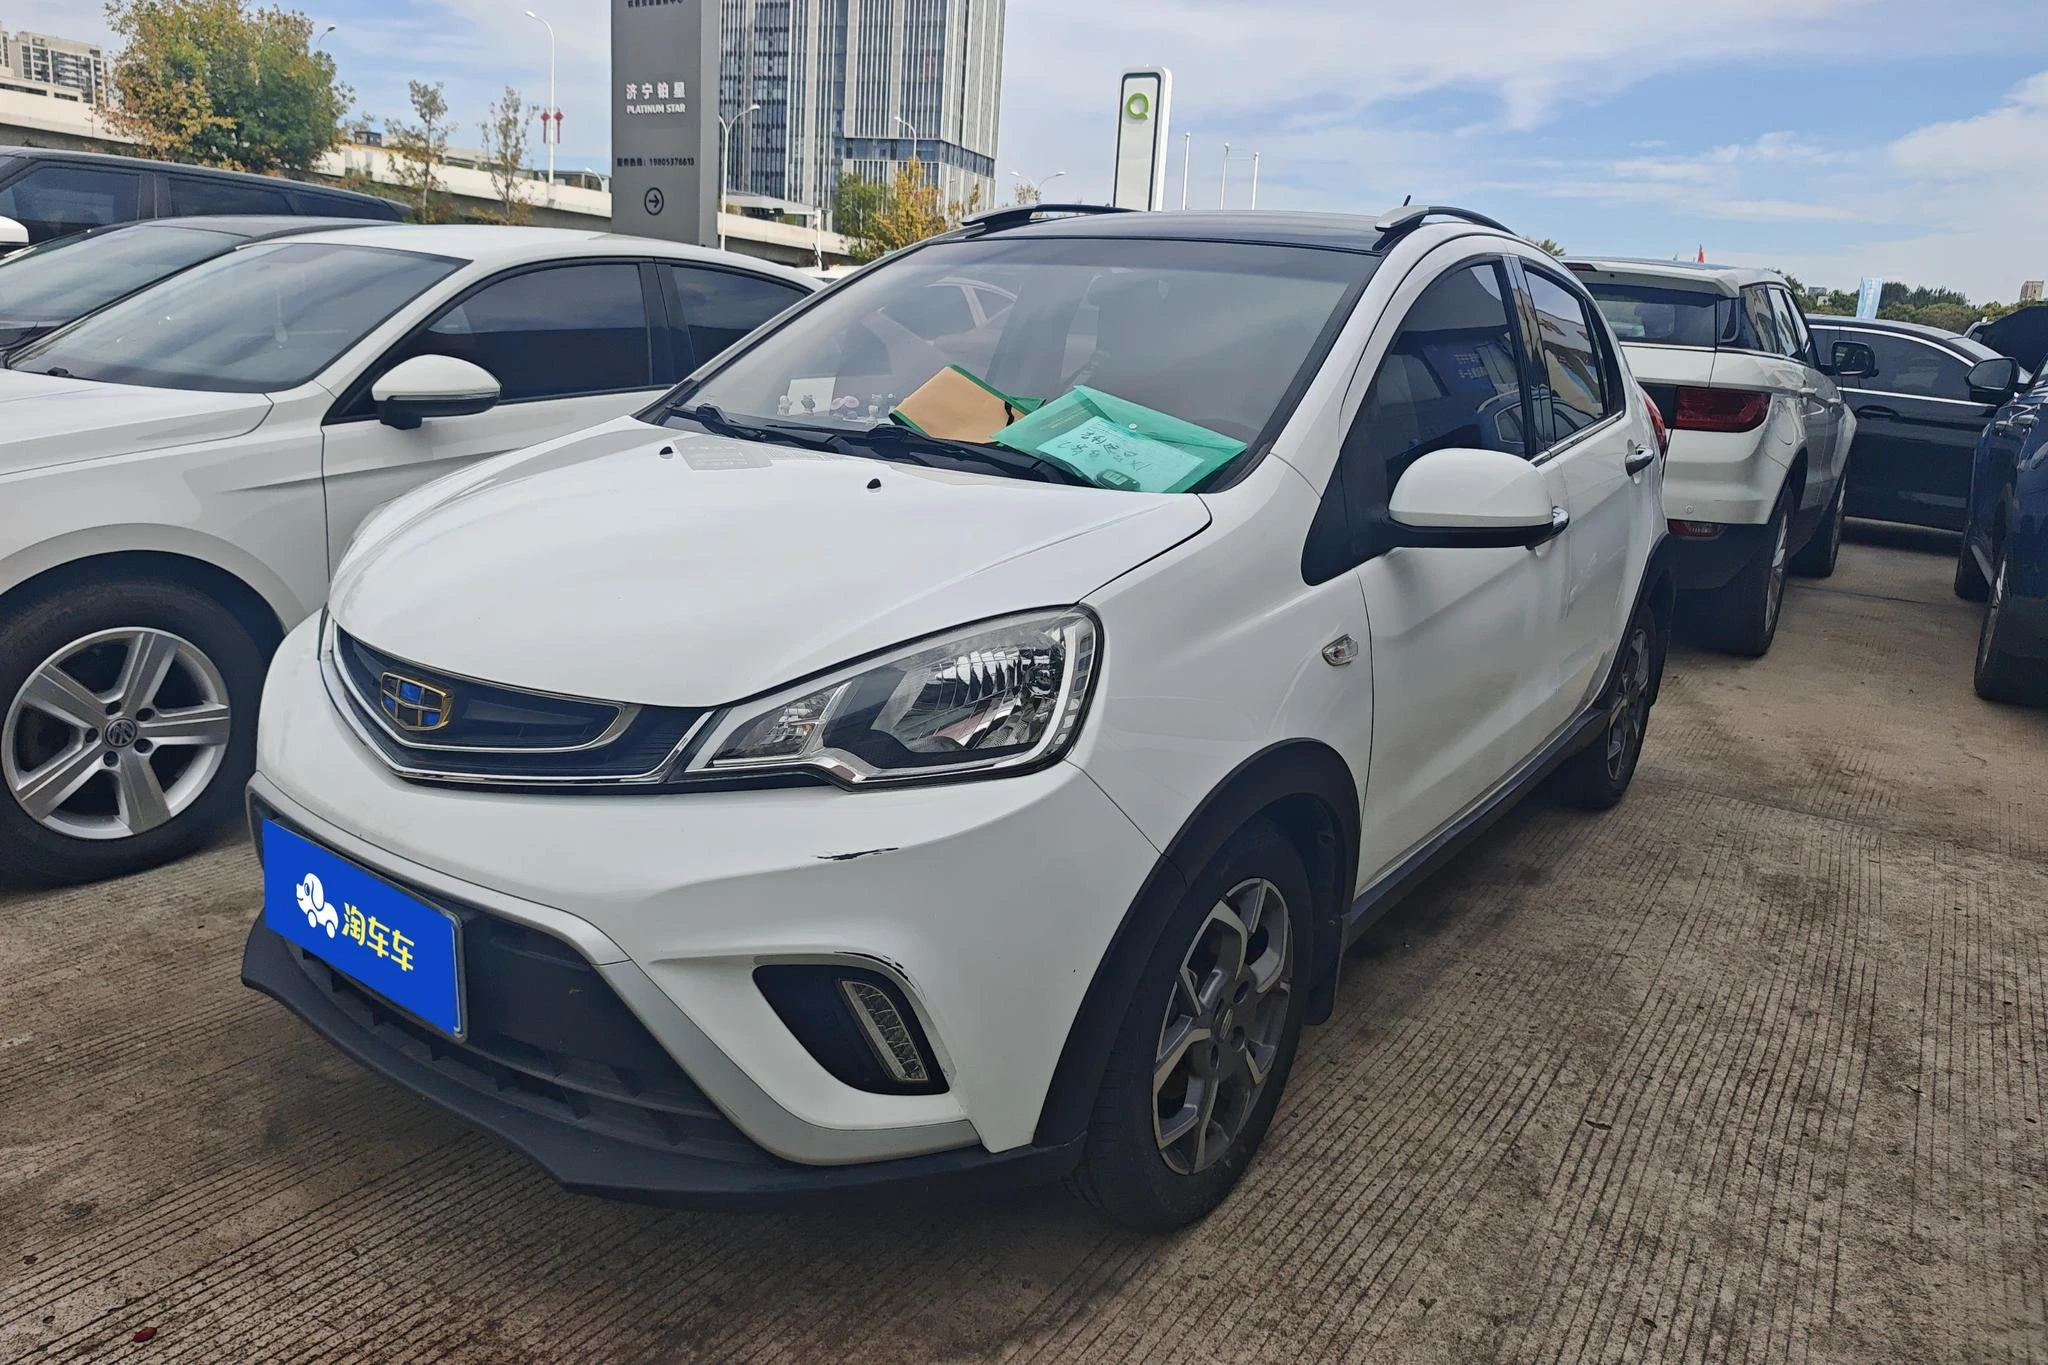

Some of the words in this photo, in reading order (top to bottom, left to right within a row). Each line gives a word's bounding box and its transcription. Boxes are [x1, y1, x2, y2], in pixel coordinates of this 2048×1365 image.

[626, 82, 685, 100] 济宁铂星
[627, 105, 664, 114] PLATINUM
[666, 104, 686, 113] STAR
